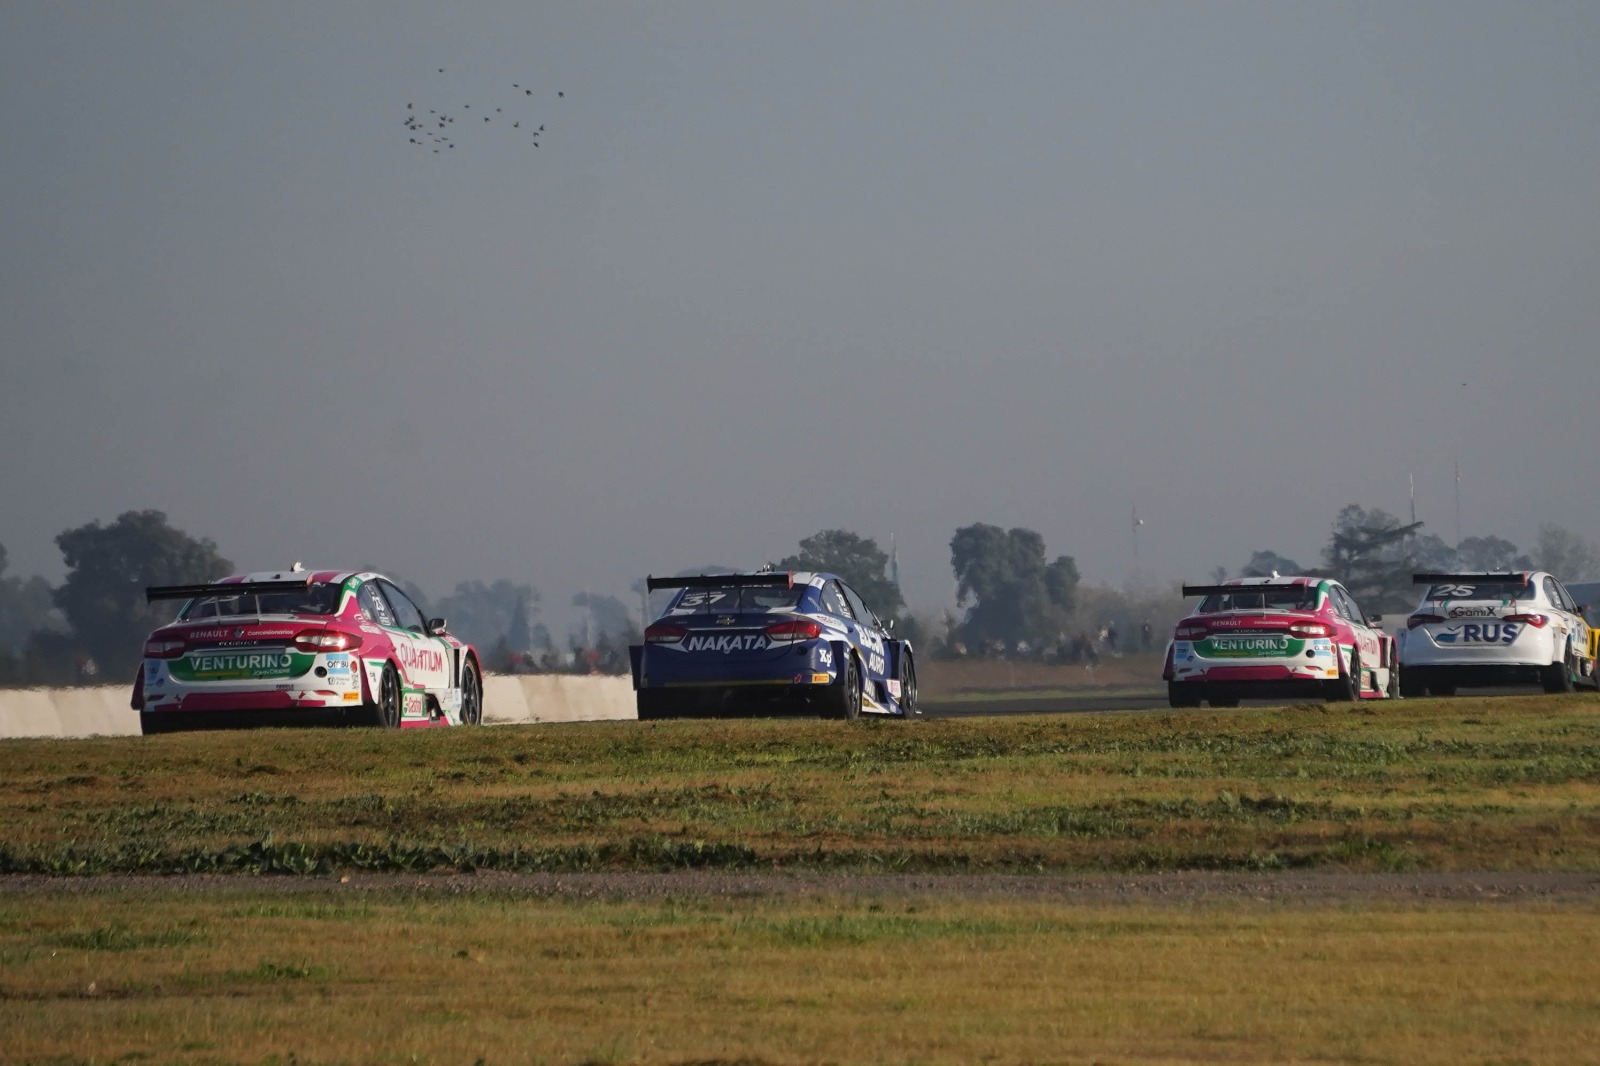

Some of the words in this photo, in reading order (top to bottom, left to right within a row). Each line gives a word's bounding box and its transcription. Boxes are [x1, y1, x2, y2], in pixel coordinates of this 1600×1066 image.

[1433, 584, 1477, 597] 25
[681, 594, 727, 607] 37
[190, 630, 228, 639] RENAULT
[1464, 624, 1519, 643] RUS
[688, 635, 767, 651] NAKATA
[1211, 640, 1289, 650] VENTURINO
[189, 654, 292, 671] VENTURINO
